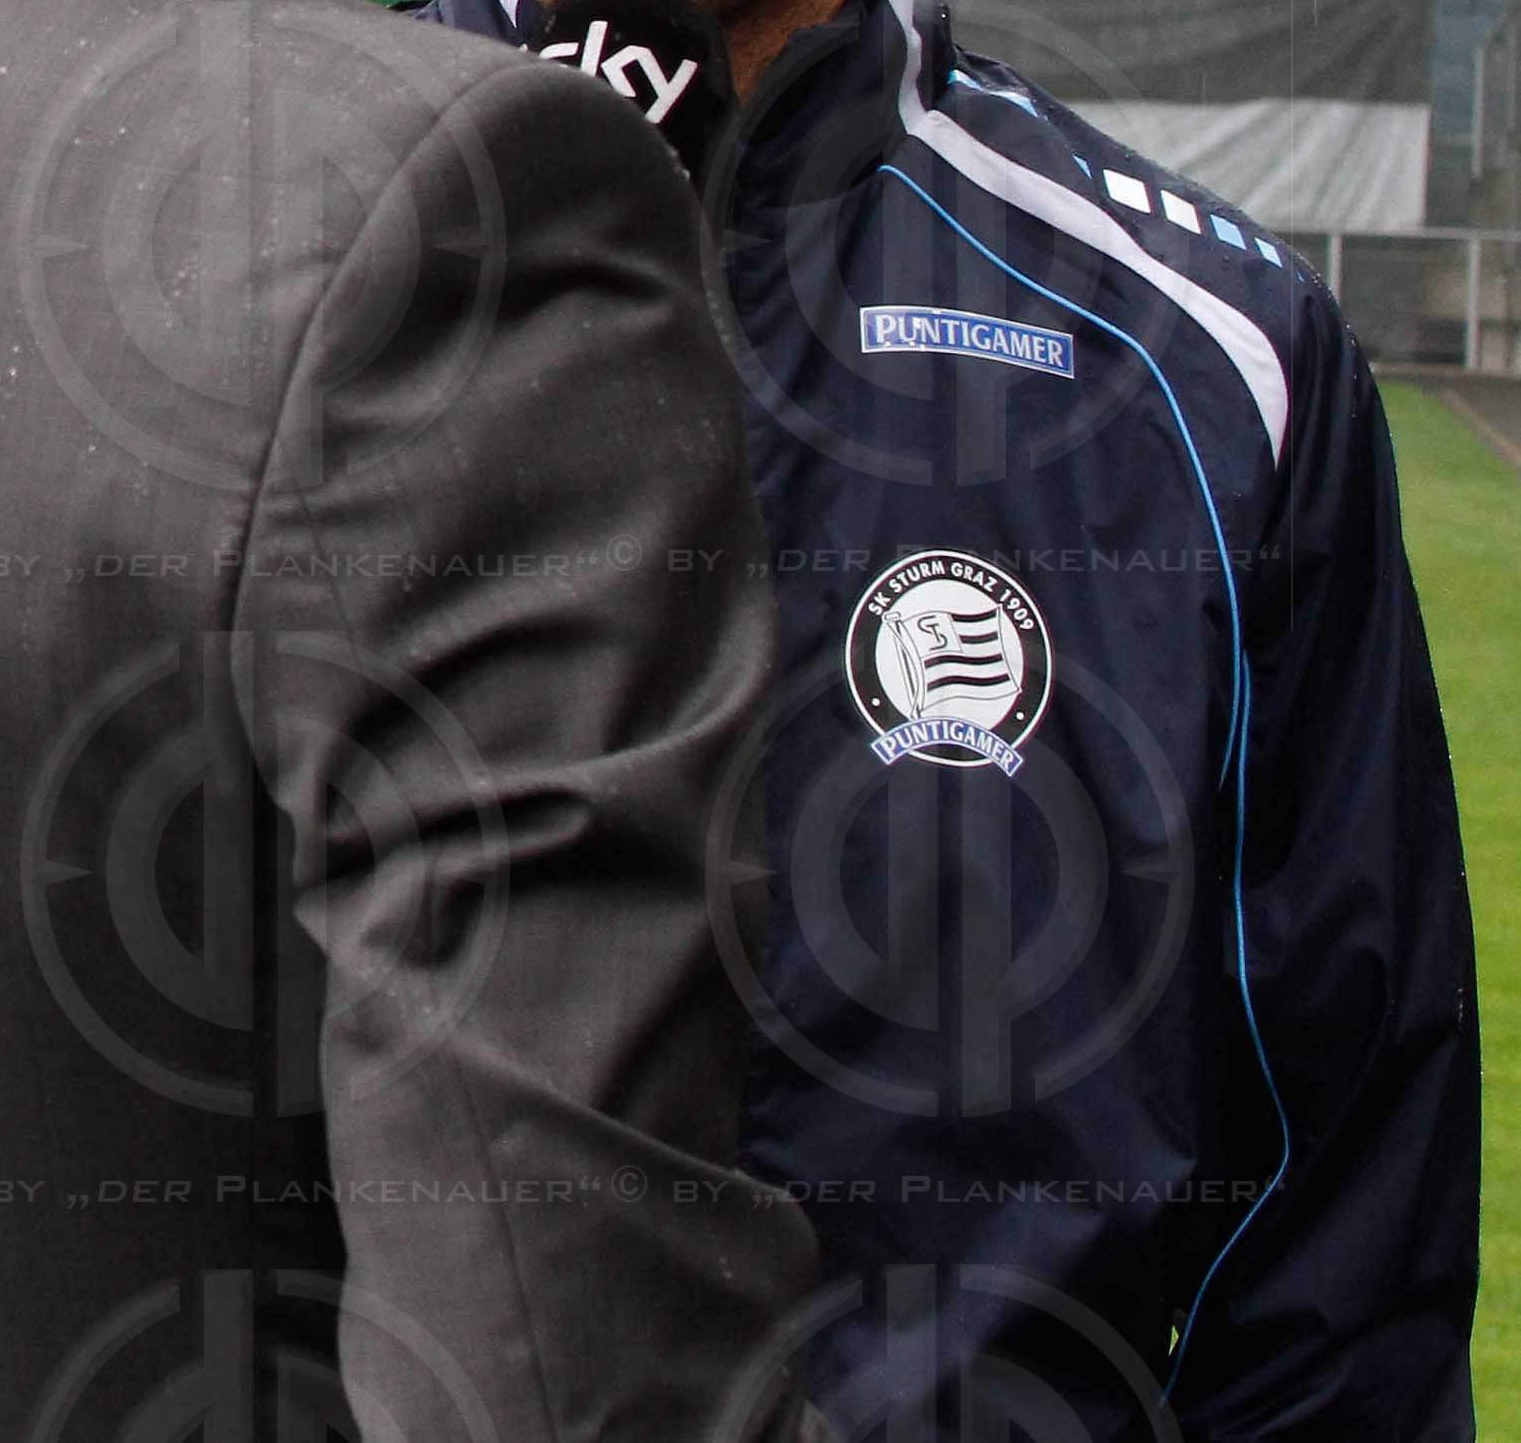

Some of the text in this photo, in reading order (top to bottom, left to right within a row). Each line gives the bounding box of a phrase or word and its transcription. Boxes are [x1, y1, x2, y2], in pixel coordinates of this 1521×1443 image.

[538, 20, 698, 124] ky
[874, 314, 1065, 369] PUNTIGAMER
[868, 560, 1034, 630] SK STURM GRAZ 1909
[878, 720, 1016, 770] PUNTIGAMER
